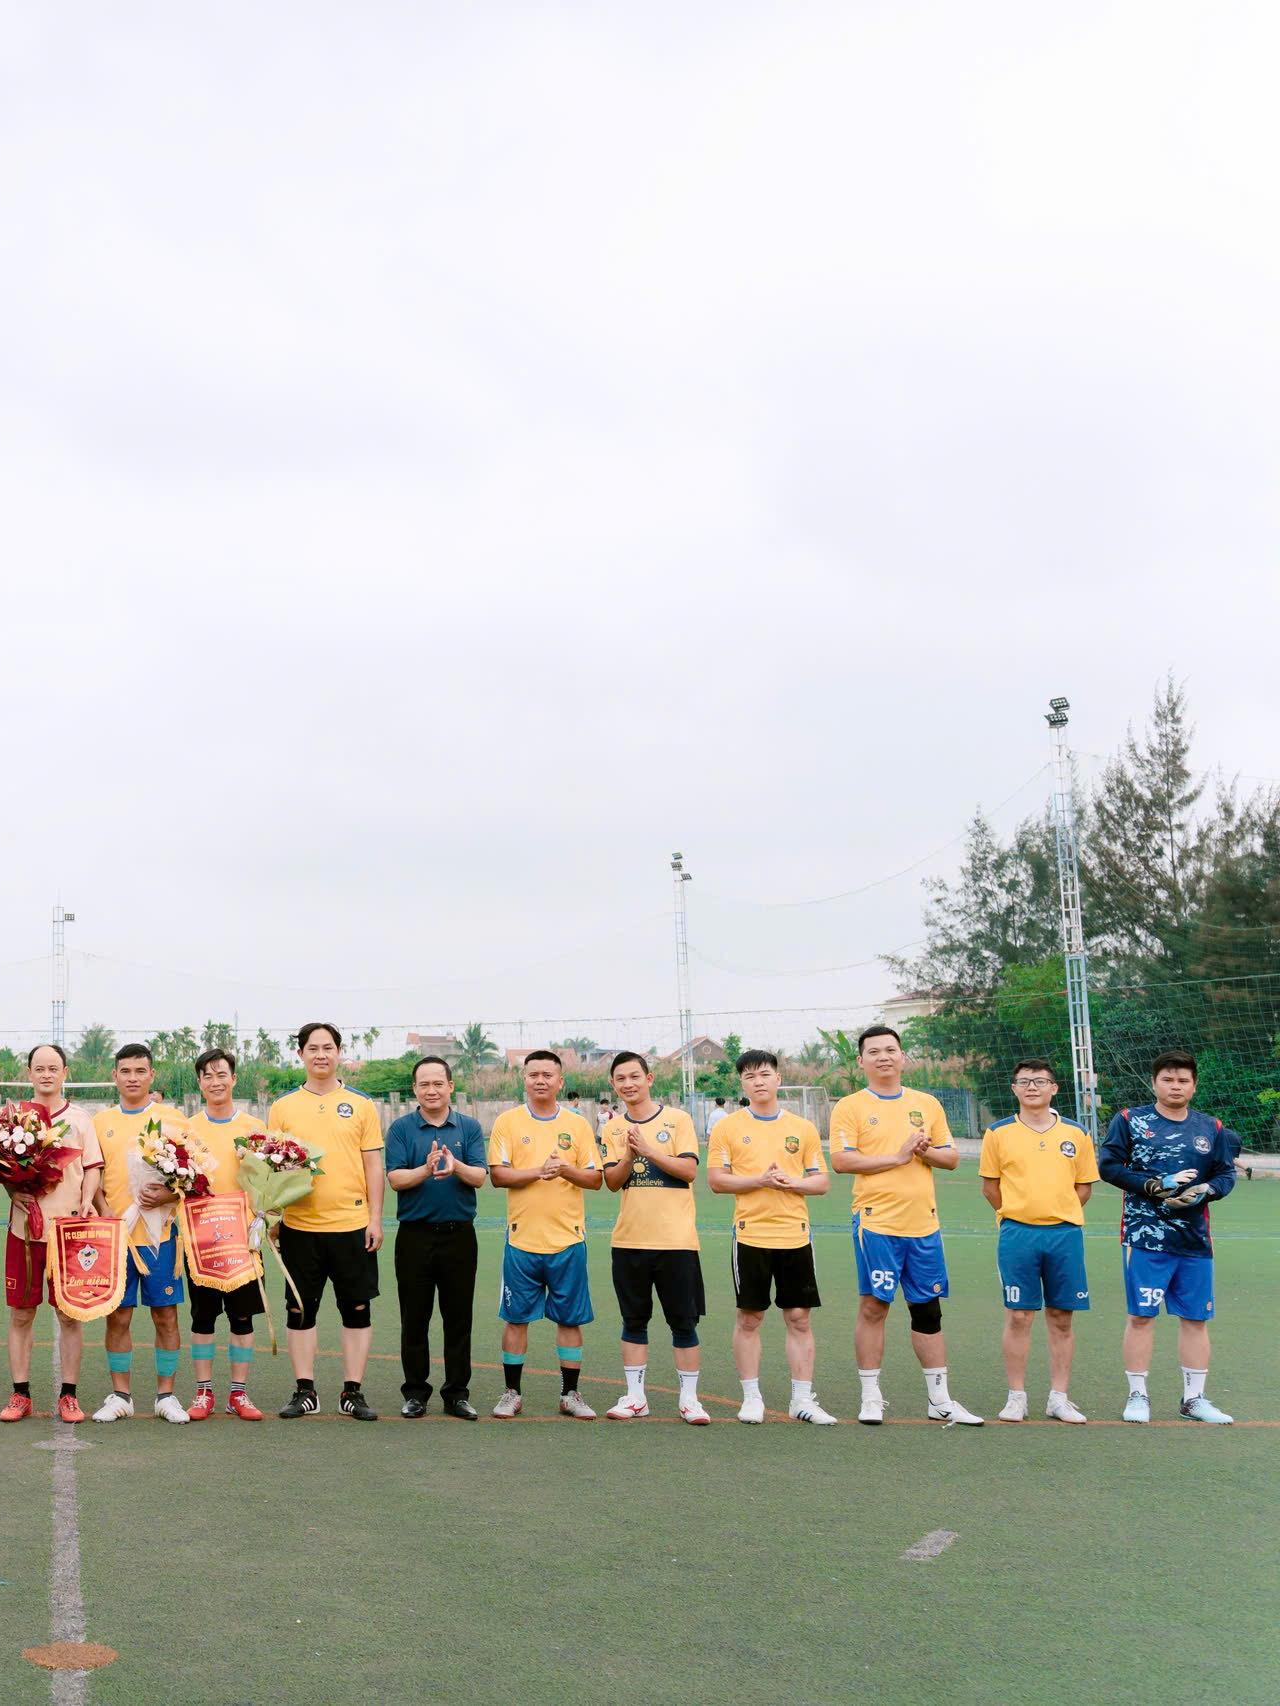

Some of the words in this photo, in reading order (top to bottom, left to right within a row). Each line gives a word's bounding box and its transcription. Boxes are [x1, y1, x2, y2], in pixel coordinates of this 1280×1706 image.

[636, 1178, 664, 1187] Bellevie
[871, 1269, 895, 1290] 95
[1004, 1285, 1020, 1303] 10
[1138, 1287, 1165, 1307] 39
